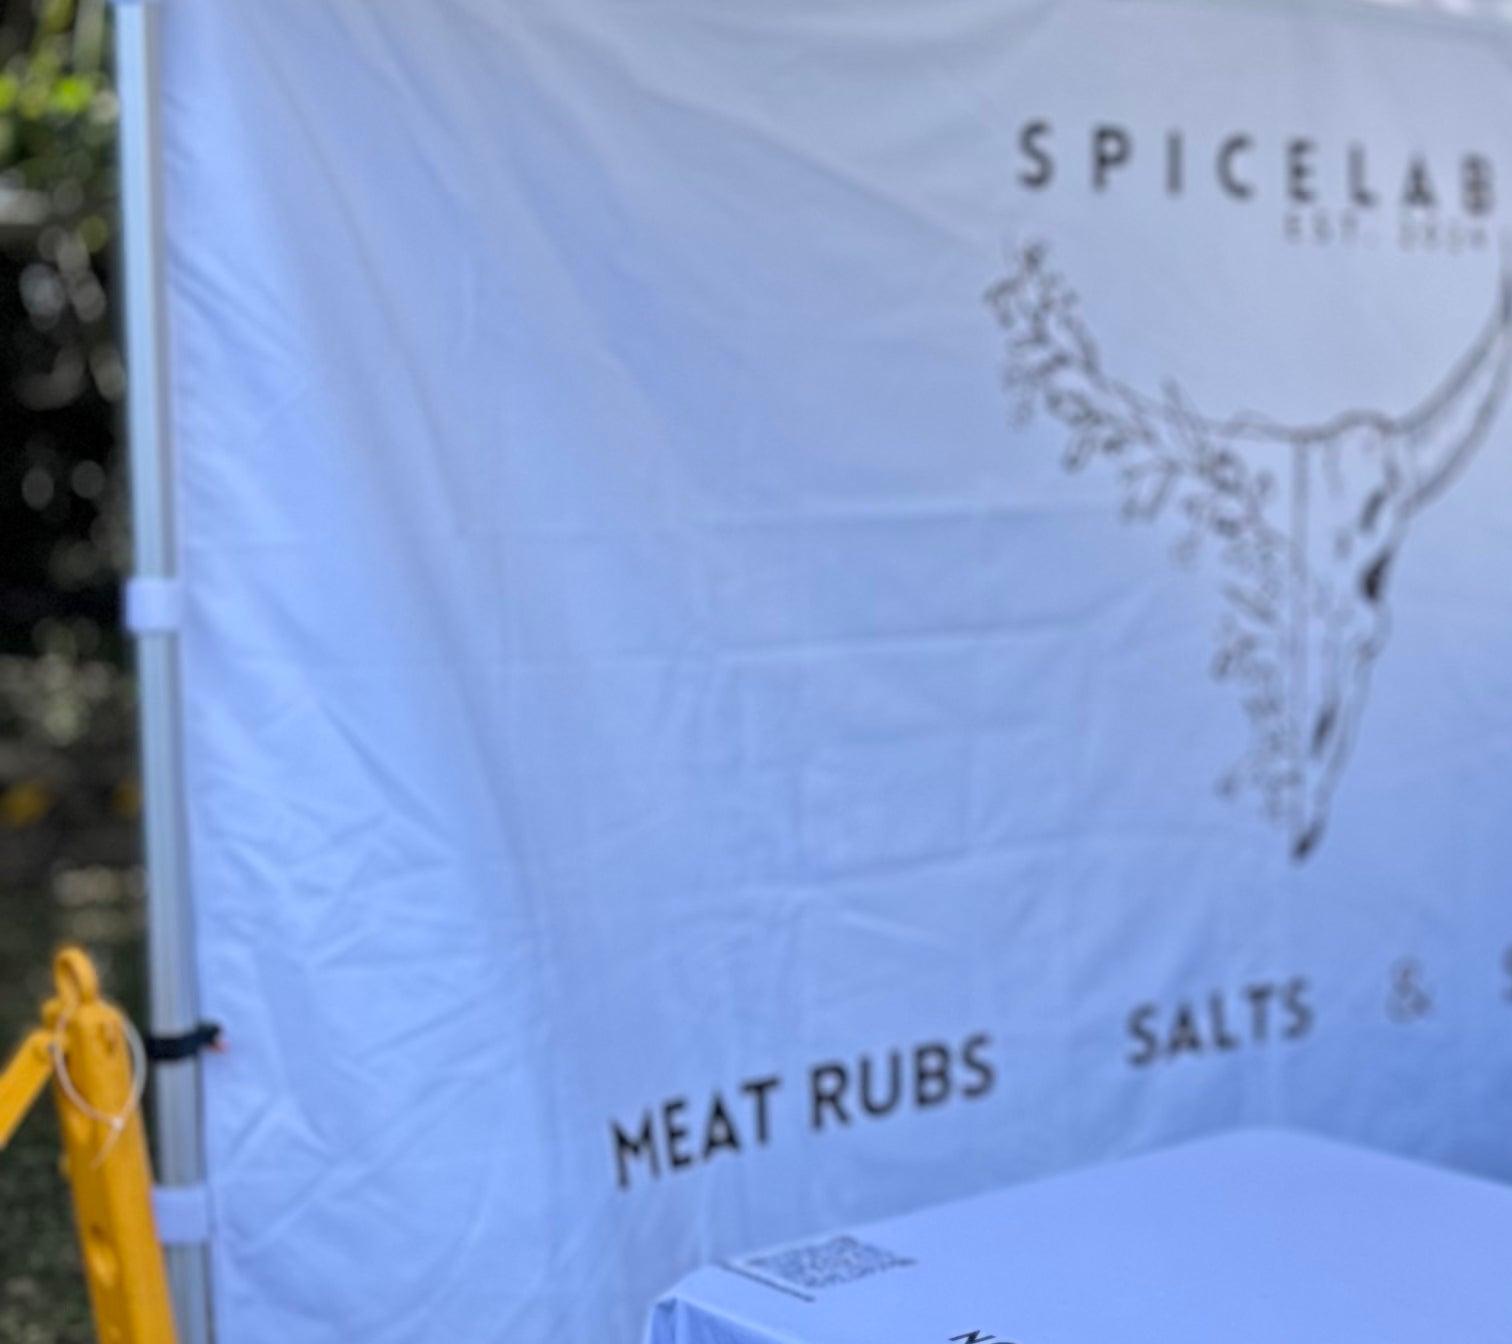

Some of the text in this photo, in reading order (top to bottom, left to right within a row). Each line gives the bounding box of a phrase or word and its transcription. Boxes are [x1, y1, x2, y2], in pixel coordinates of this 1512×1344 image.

[1017, 119, 1496, 215] SPICELAB
[610, 1075, 781, 1191] MEAT
[808, 1032, 994, 1132] RUBS
[1125, 978, 1316, 1068] SALTS
